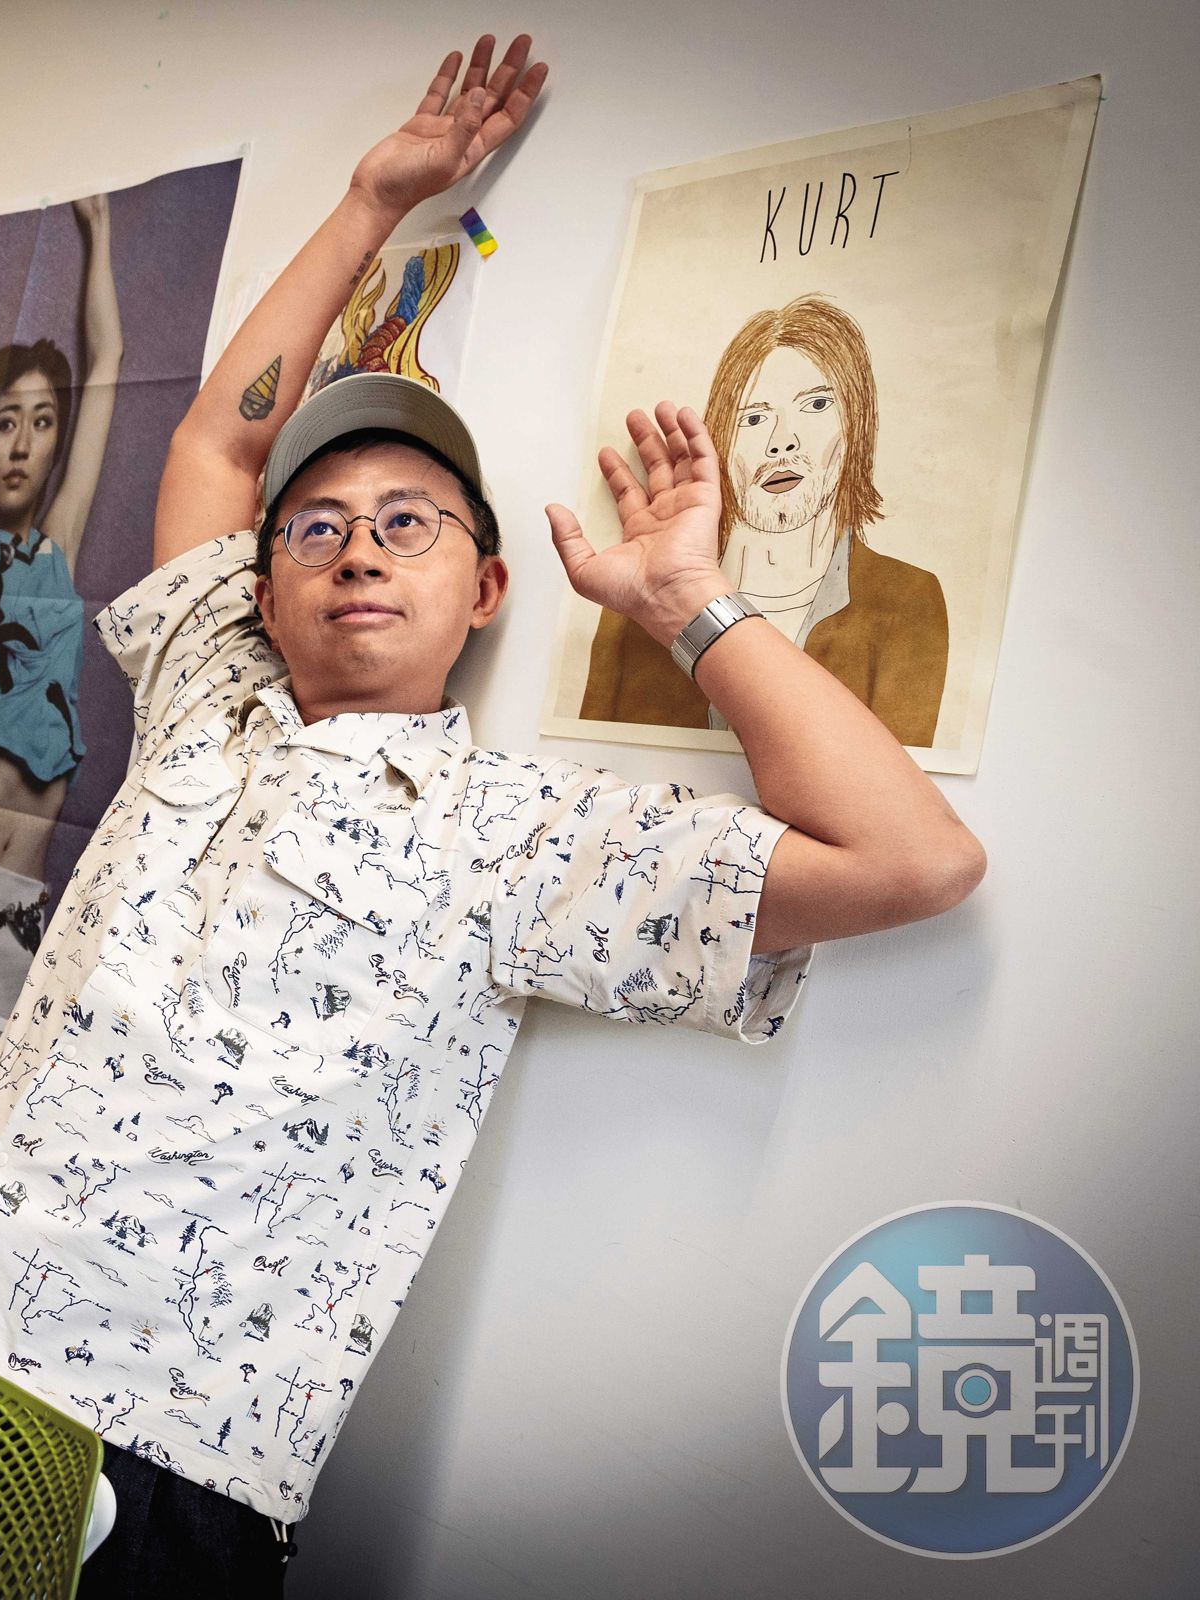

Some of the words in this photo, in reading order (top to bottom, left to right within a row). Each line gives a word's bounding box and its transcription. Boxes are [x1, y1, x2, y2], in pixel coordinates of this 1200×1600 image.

[759, 171, 900, 263] KURT
[506, 821, 547, 861] California
[231, 952, 248, 1009] California
[393, 970, 430, 1004] California
[142, 1054, 185, 1092] California
[146, 1147, 211, 1164] Washington
[253, 1256, 289, 1274] Oregon
[8, 1353, 42, 1370] Oregon
[169, 1368, 211, 1401] California
